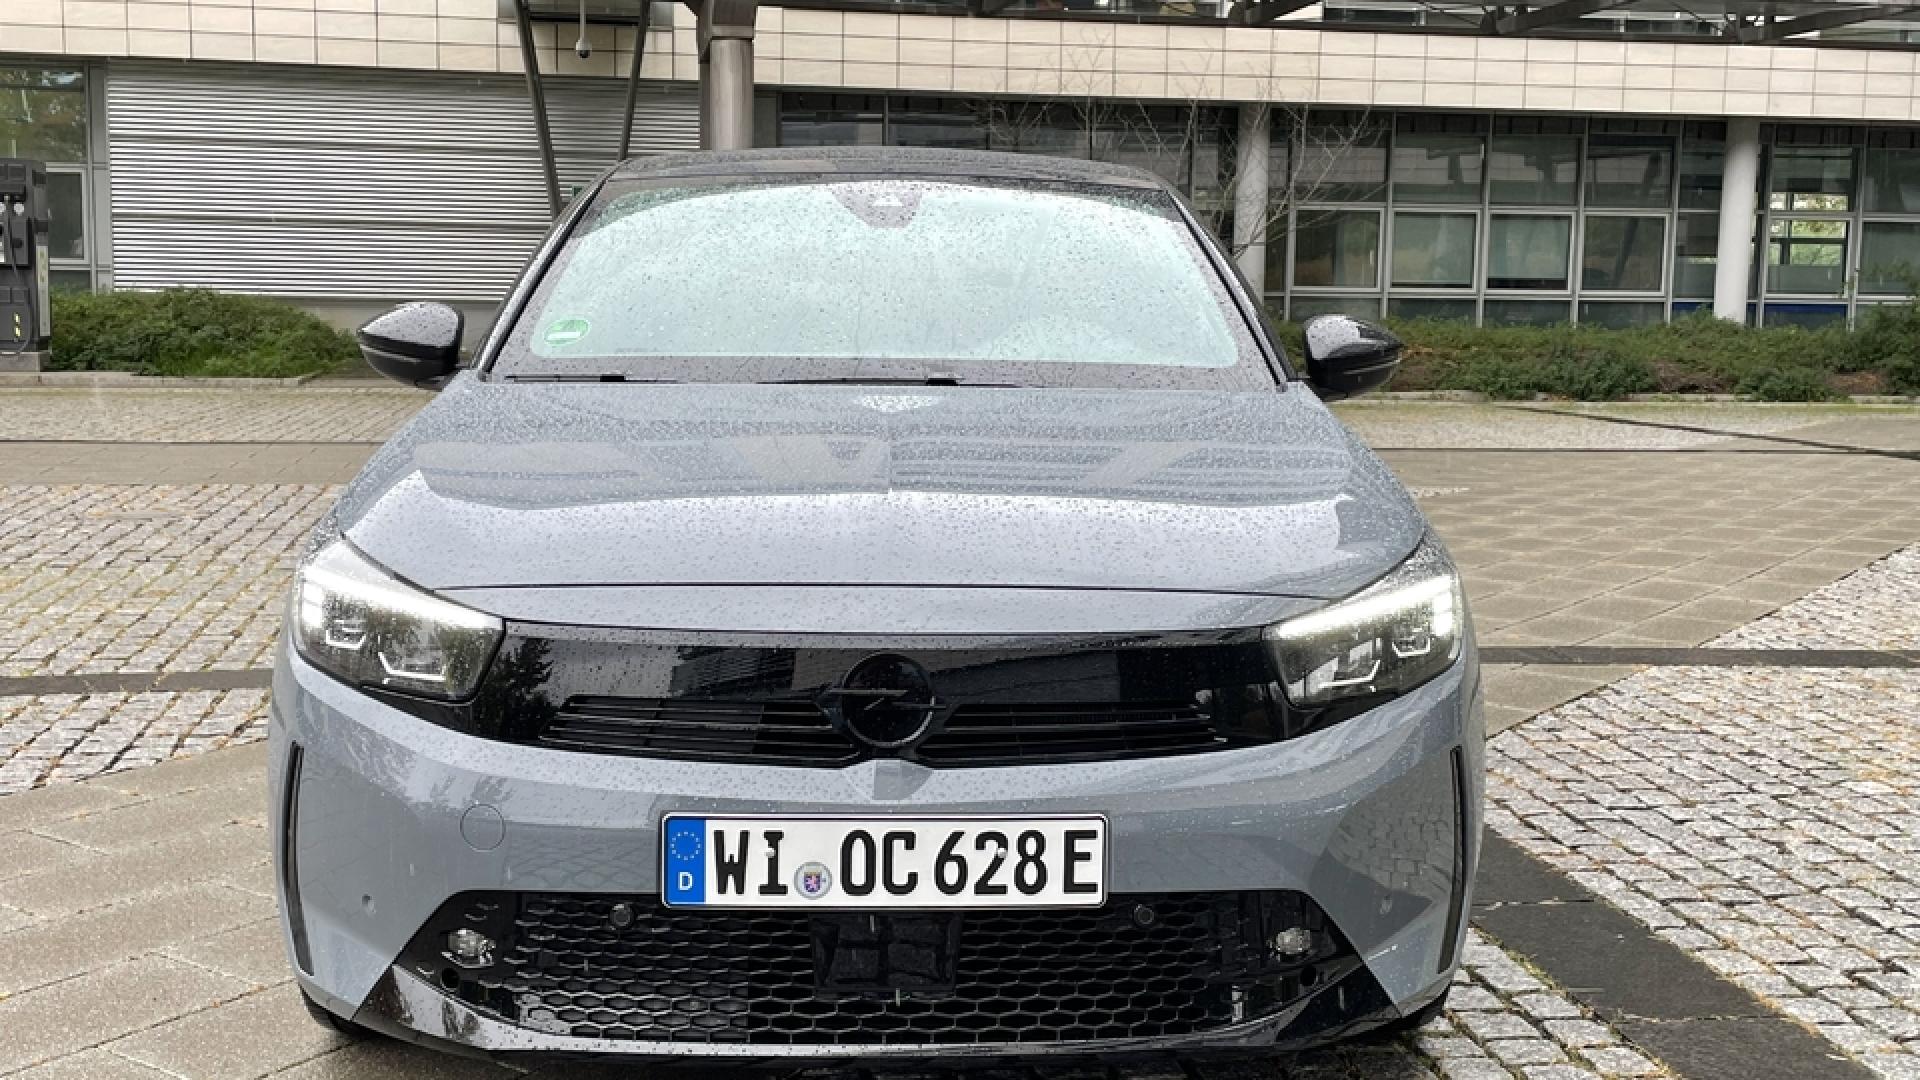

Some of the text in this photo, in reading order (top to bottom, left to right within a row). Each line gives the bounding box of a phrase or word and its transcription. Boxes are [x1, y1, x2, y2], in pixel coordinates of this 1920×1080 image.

[679, 872, 693, 891] D
[713, 829, 788, 895] WI
[841, 829, 919, 896] OC
